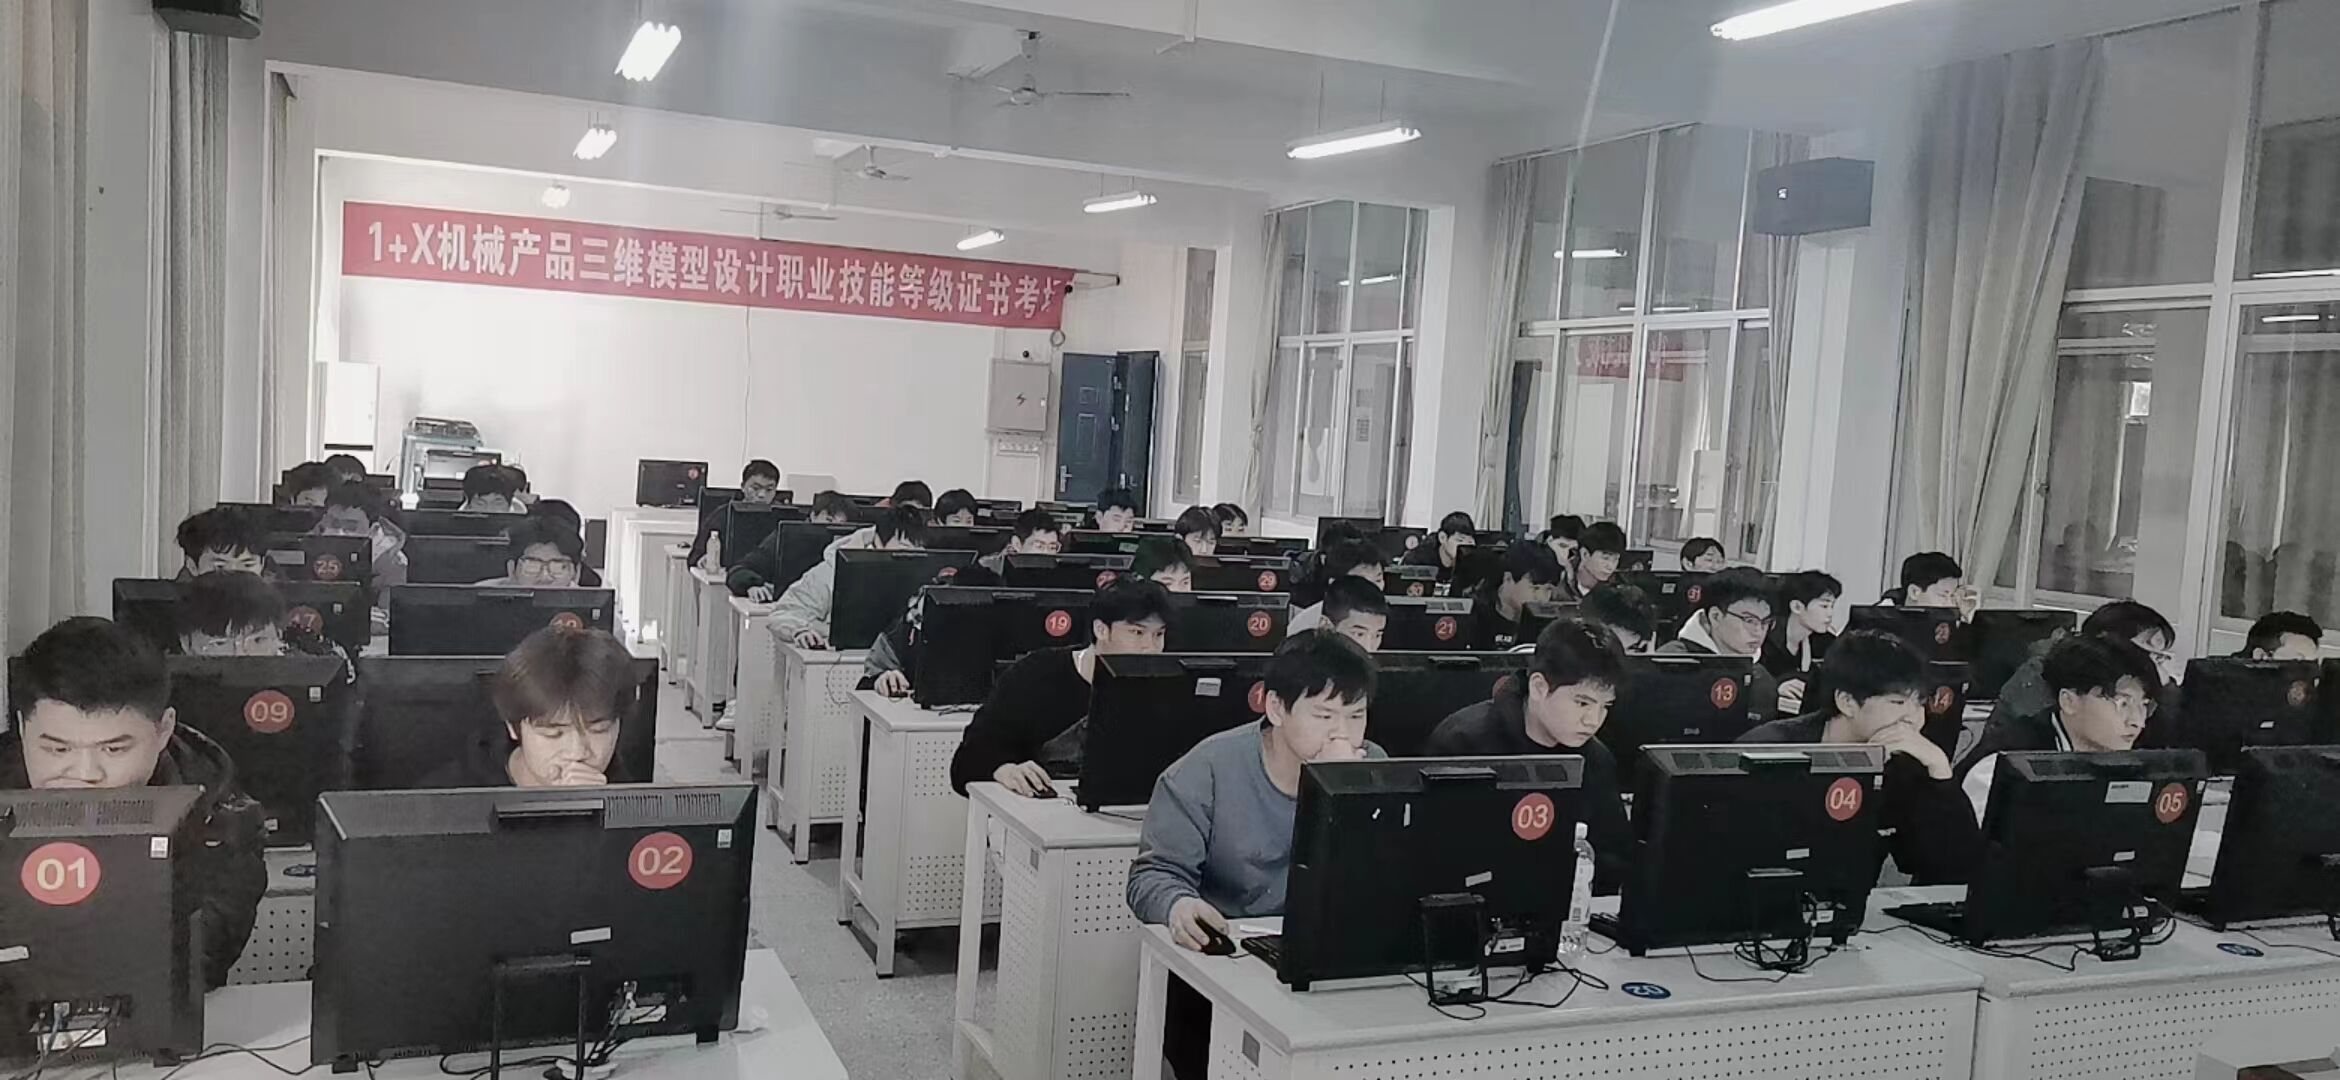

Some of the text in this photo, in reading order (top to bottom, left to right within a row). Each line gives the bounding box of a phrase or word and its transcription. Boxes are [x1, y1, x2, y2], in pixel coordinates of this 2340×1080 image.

[319, 560, 339, 576] 25
[1050, 616, 1067, 630] 19
[1249, 617, 1268, 631] 20
[1438, 622, 1453, 634] 21
[1715, 684, 1734, 701] 13
[251, 701, 287, 723] 09
[1830, 787, 1857, 810] 04
[2160, 792, 2184, 814] 05
[1517, 804, 1548, 828] 03
[638, 845, 684, 876] 02
[37, 857, 86, 890] 01
